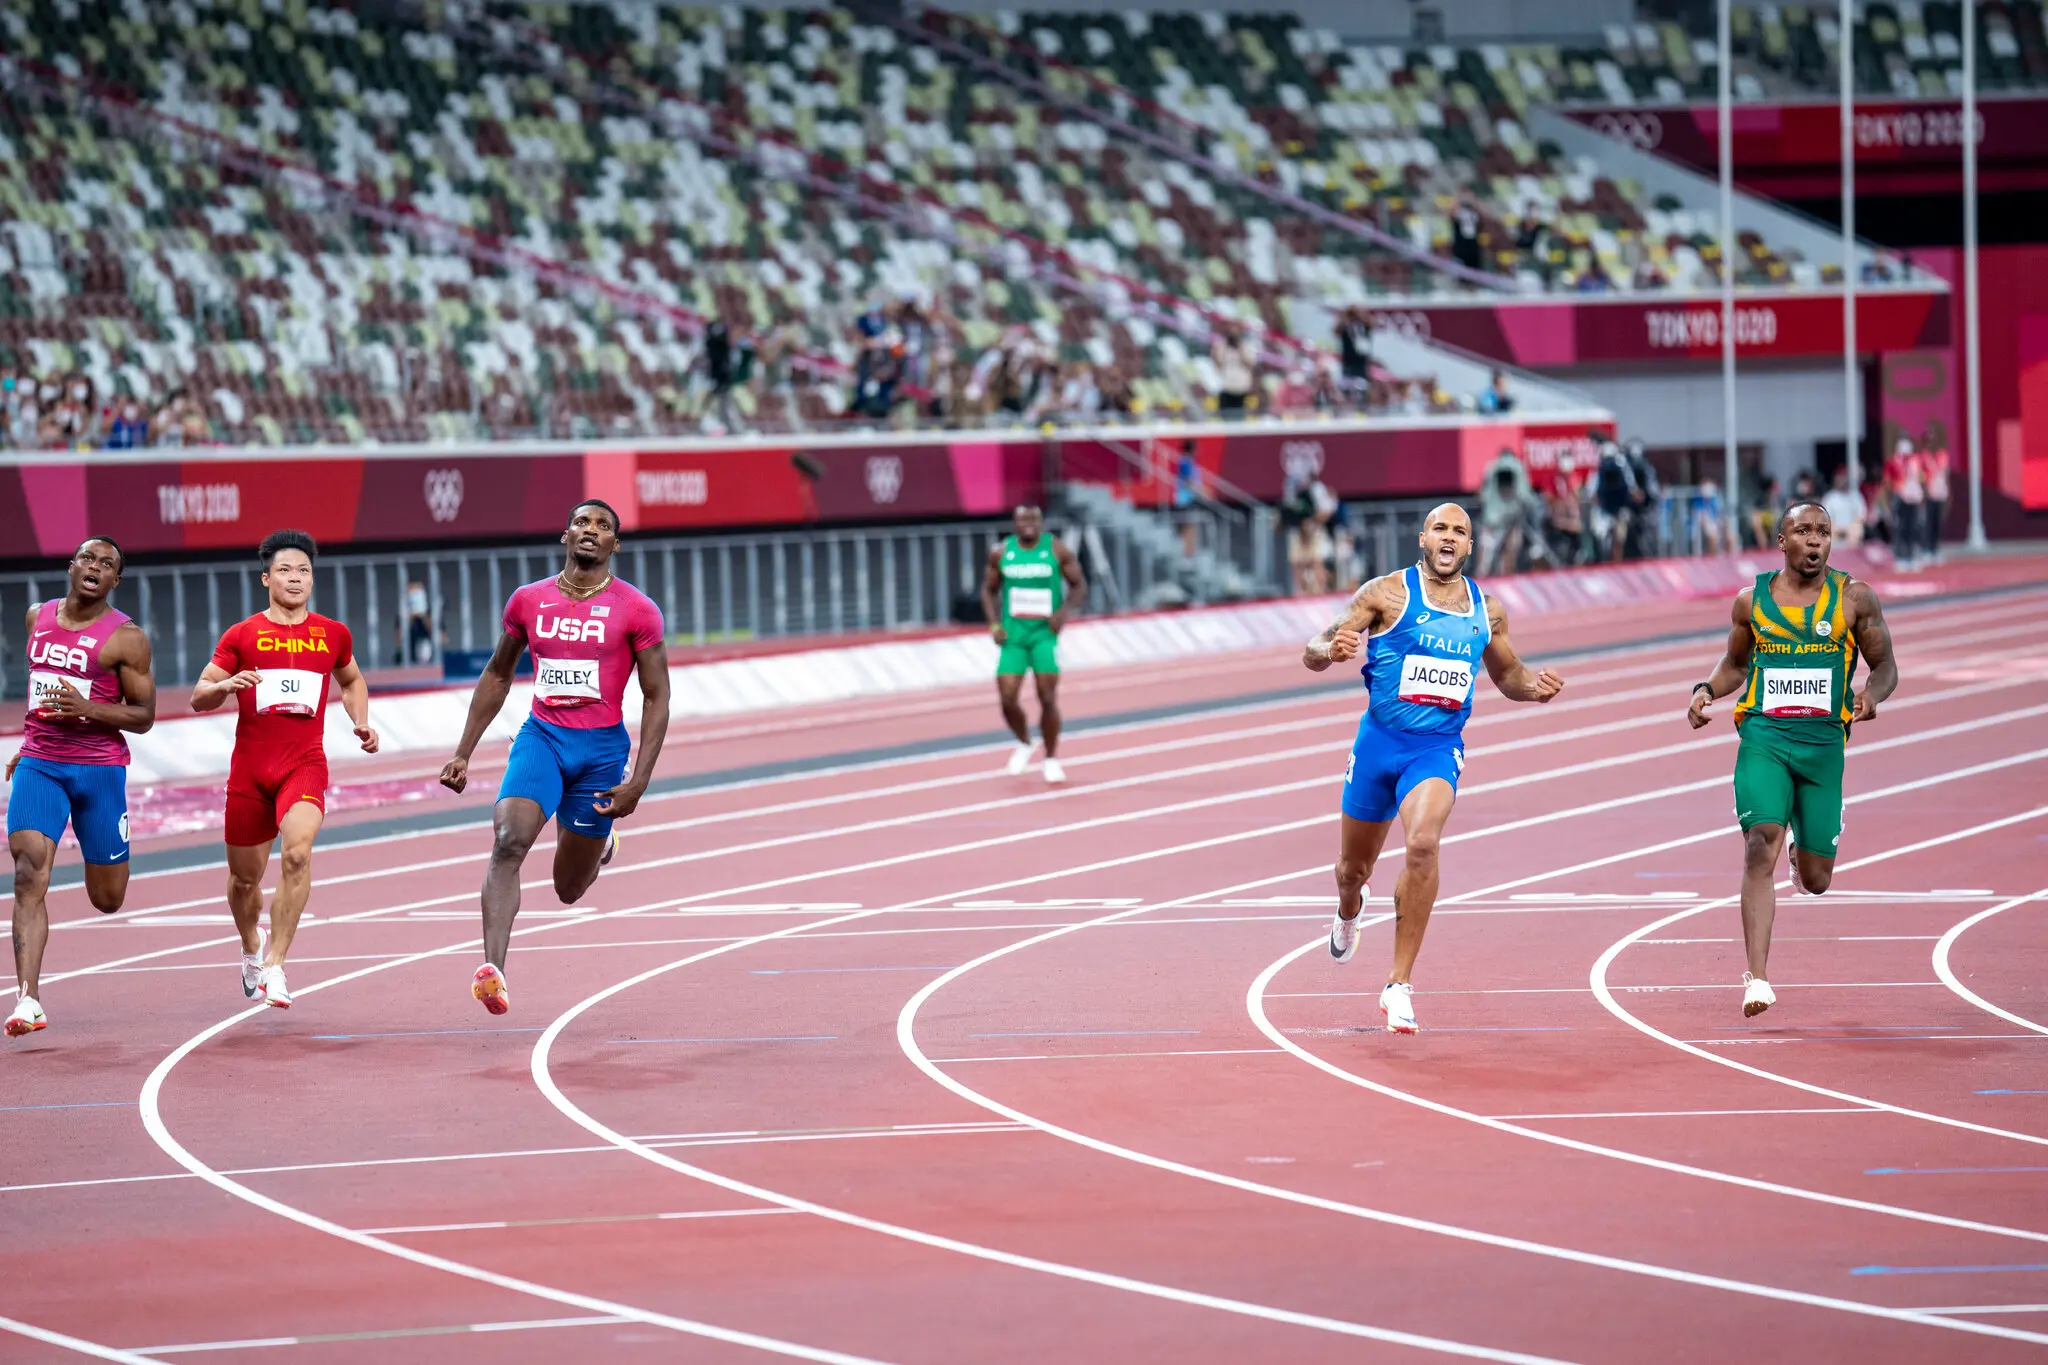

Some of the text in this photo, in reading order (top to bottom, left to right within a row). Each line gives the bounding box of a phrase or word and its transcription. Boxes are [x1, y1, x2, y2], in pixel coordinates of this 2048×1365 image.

[1644, 308, 1719, 348] TOKYO
[157, 483, 204, 524] TOKYO
[535, 614, 605, 644] USA
[256, 637, 330, 654] CHINA
[1419, 633, 1472, 657] ITALIA
[1794, 643, 1840, 654] AFRICA
[29, 640, 89, 673] USA
[280, 679, 300, 693] SU
[540, 668, 592, 685] KERLEY
[1408, 666, 1469, 687] JACOBS
[1768, 679, 1828, 695] SIMBINE
